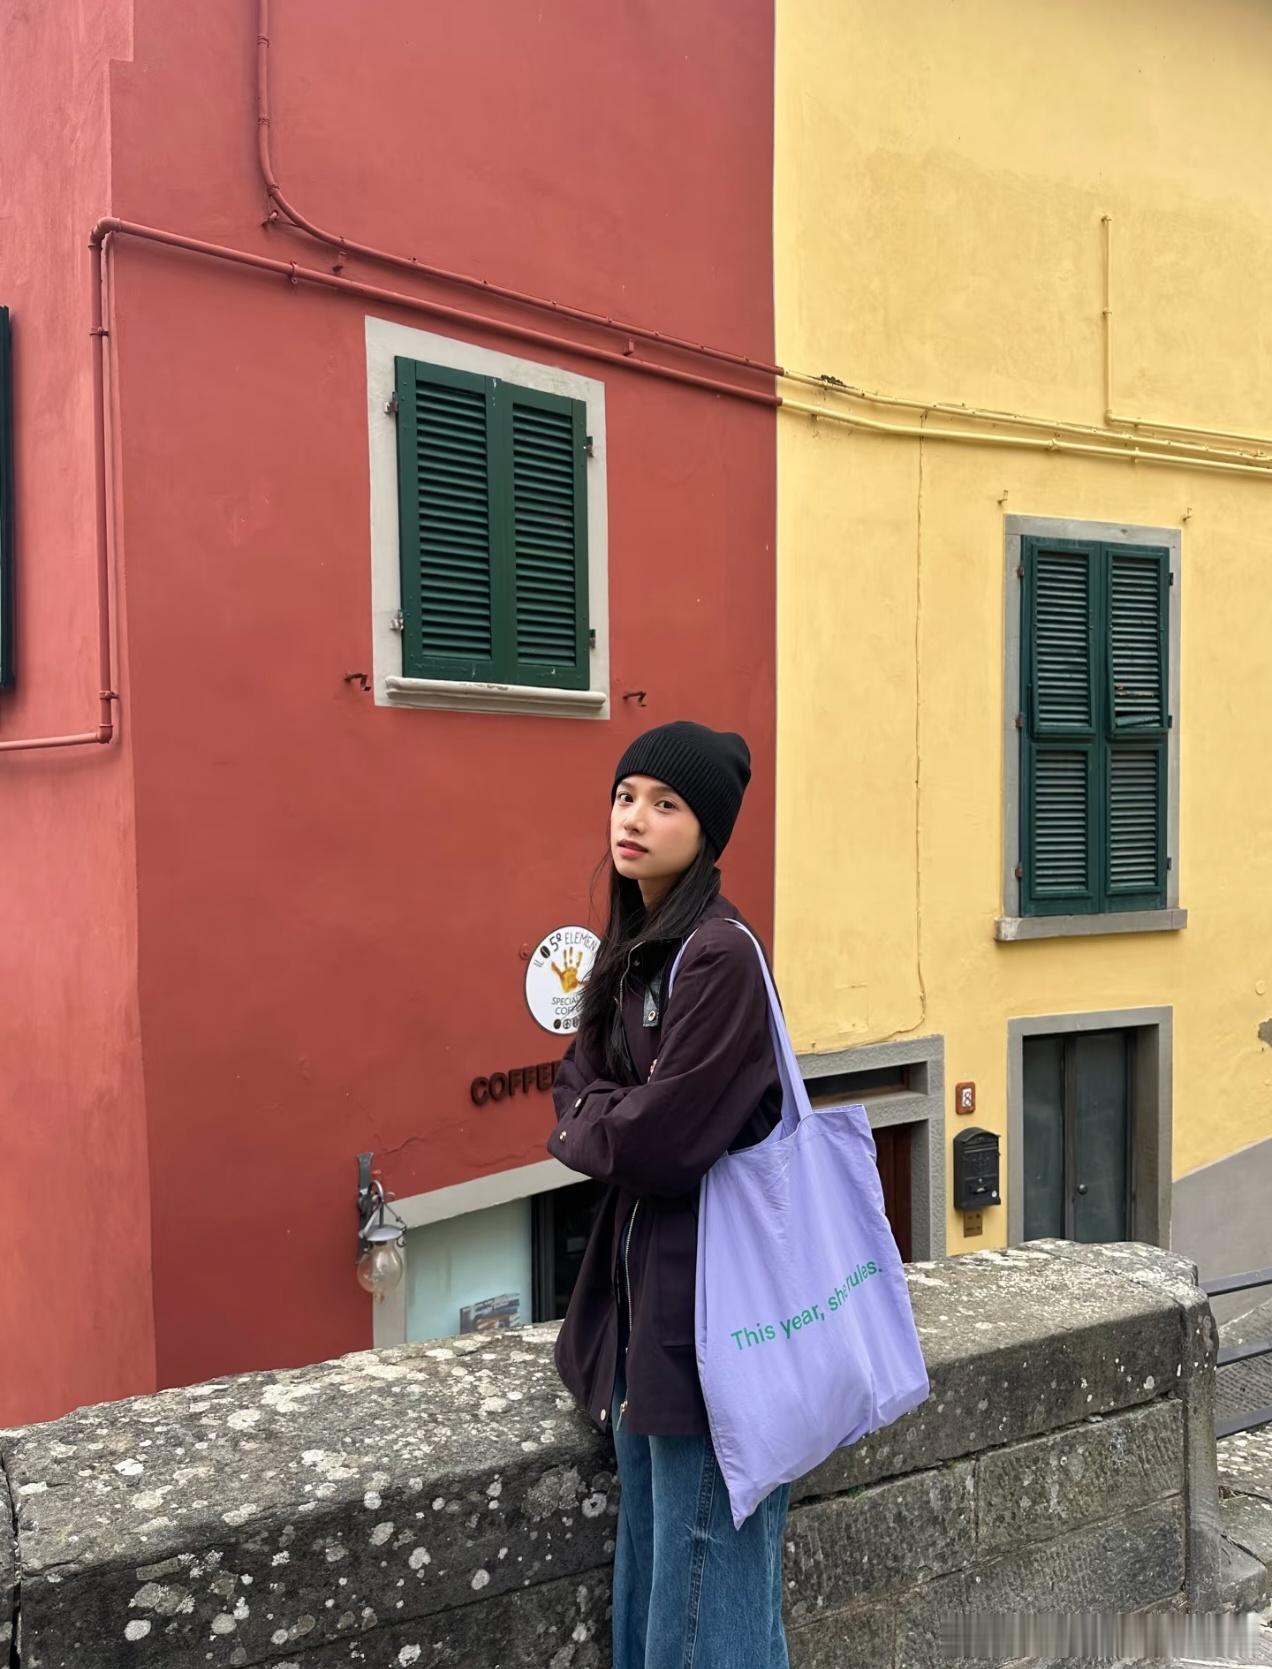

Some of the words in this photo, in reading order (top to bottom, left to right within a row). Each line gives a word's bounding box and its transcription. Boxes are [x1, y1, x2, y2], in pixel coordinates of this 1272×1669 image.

[552, 996, 579, 1006] SPECIA
[730, 1322, 776, 1351] This
[780, 1304, 825, 1339] year,
[846, 1260, 883, 1291] rules.
